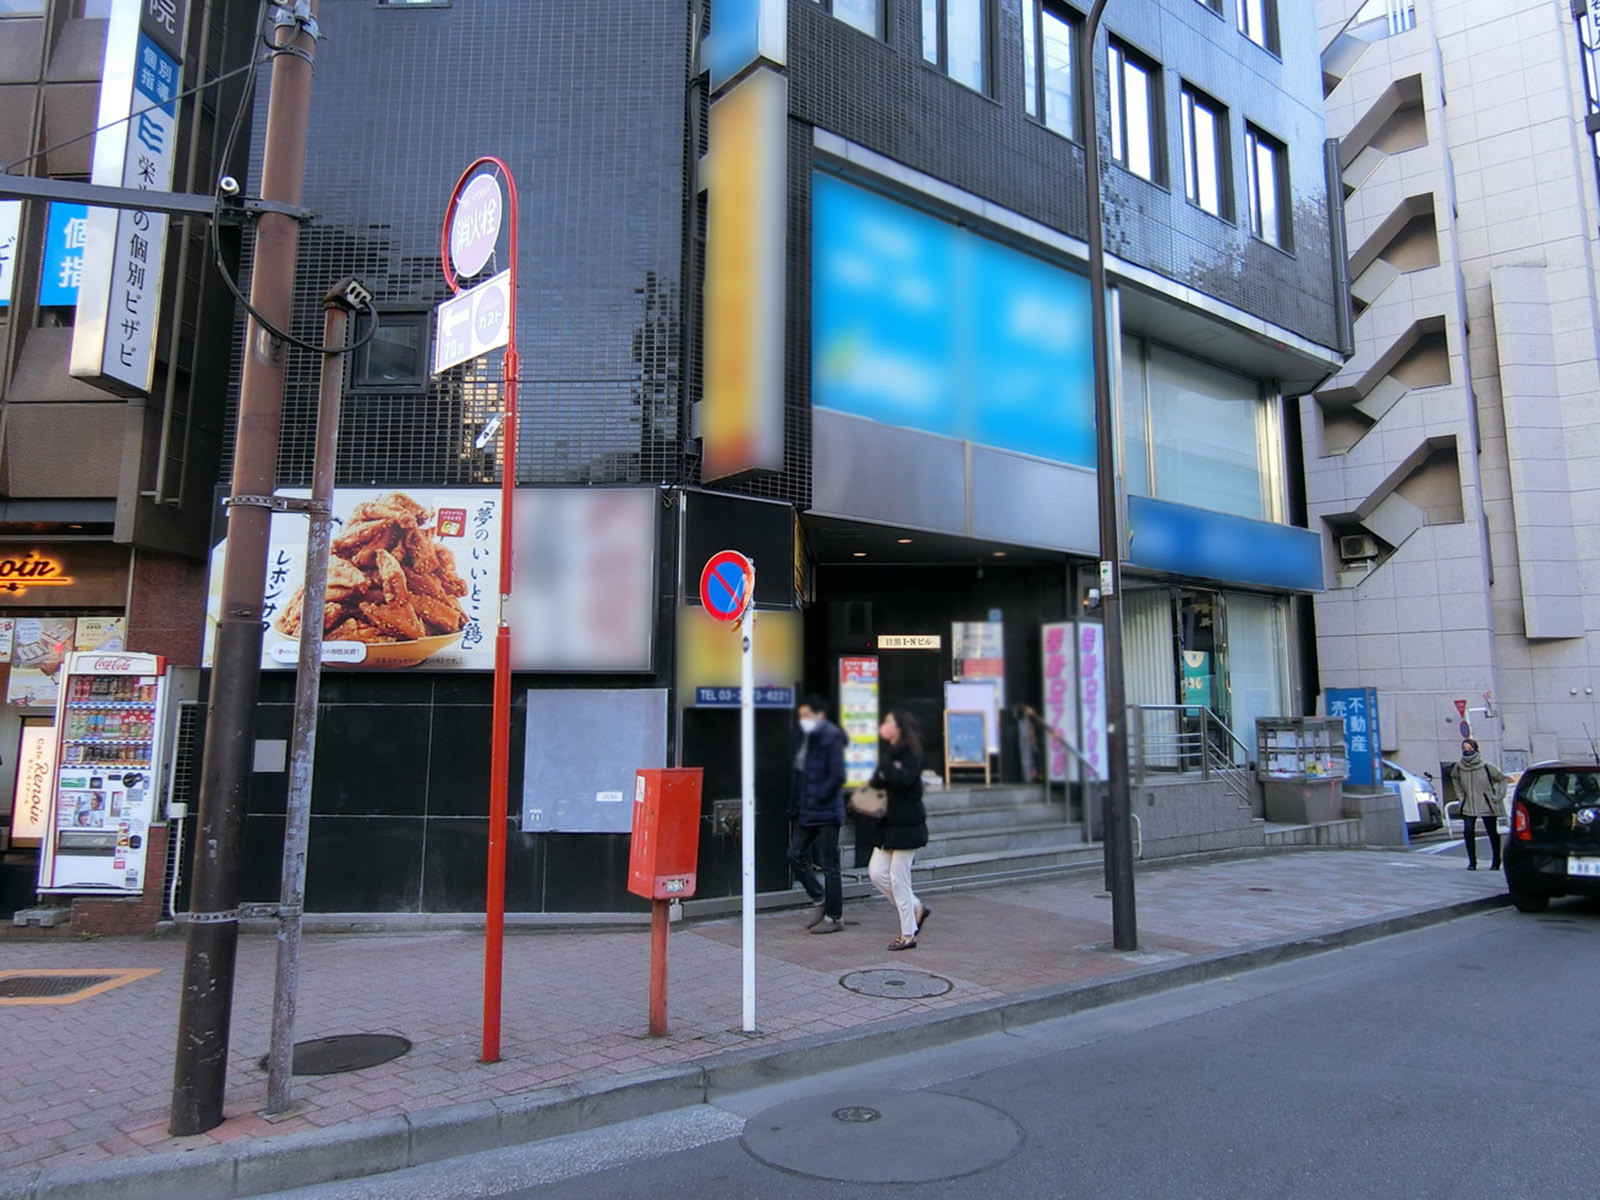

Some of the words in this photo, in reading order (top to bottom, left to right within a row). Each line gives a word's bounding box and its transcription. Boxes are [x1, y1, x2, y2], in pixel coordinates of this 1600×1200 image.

[456, 197, 498, 255] 消火栓
[120, 155, 157, 368] 栄の個別ビザビ
[700, 689, 717, 701] TEL
[1347, 696, 1368, 752] 不動産
